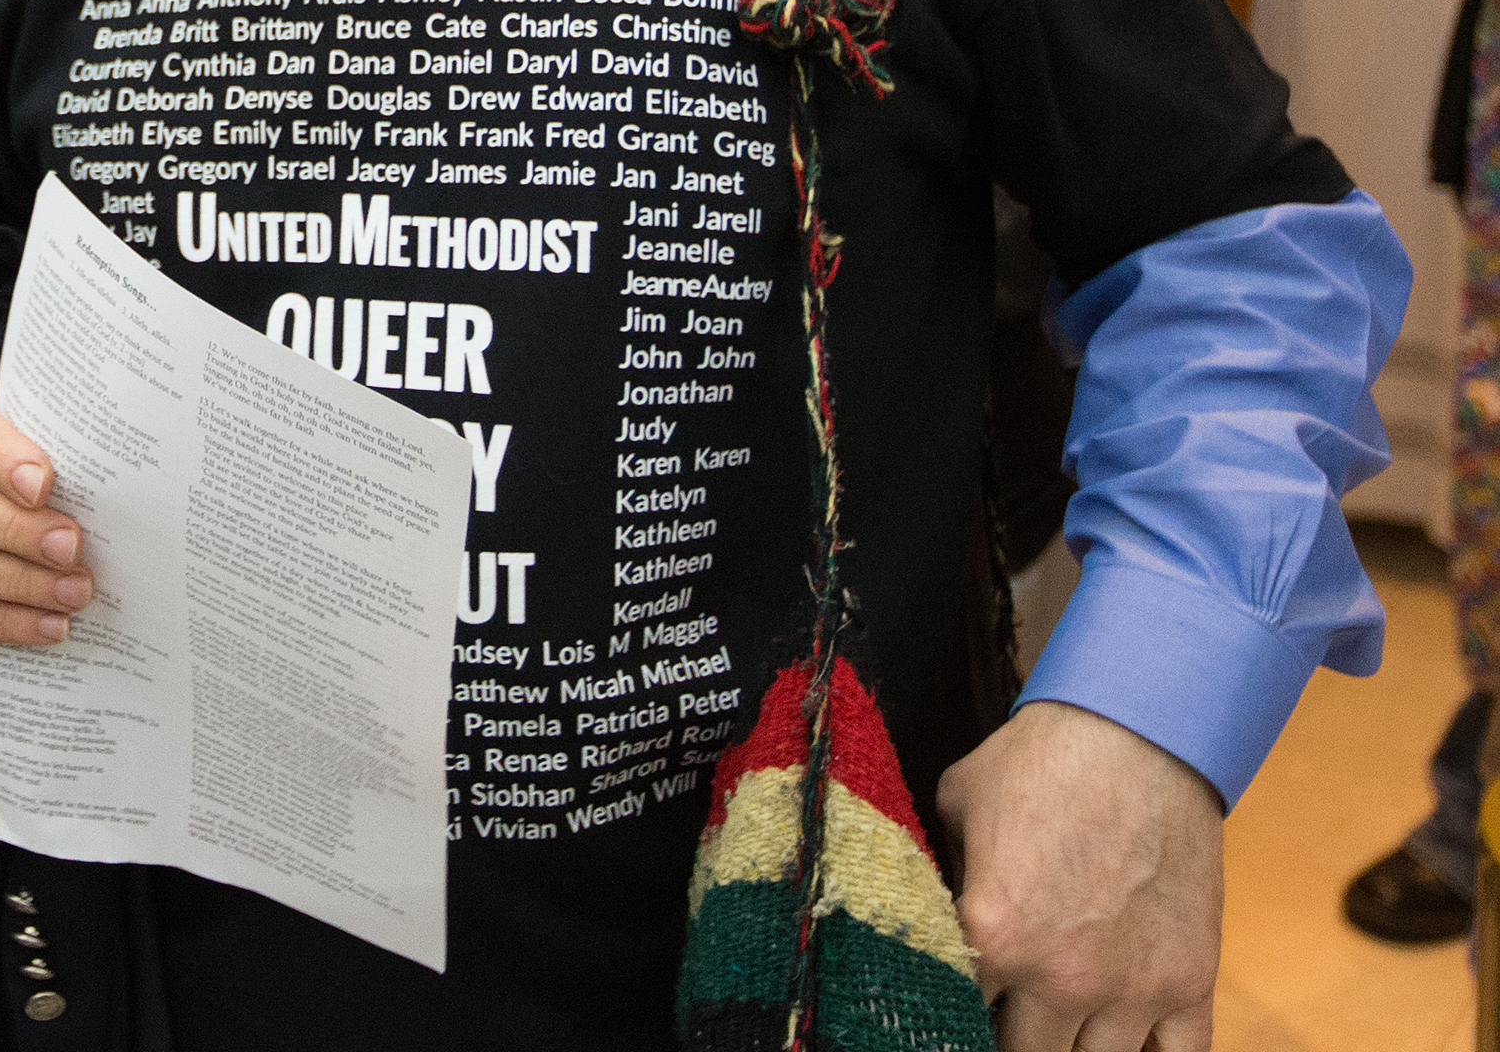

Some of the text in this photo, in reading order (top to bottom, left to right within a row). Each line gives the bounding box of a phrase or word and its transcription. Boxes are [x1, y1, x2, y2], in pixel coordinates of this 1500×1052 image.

[94, 13, 730, 49] Brenda Britt Brittany Bruce Cate Charles Christine
[69, 49, 758, 87] Courtney Cynthia Dan Dana Daniel Daryl David David
[57, 85, 766, 123] David Deborah Denyse Douglas Drew Edward Elizabeth
[53, 119, 775, 167] Elizabeth Elyse Emily Emily Frank Frank Fred Grant Greg
[70, 155, 744, 195] Gregory Gregory Israel Jacey James Jamie Jan Janet
[101, 192, 155, 214] Janet
[623, 201, 761, 233] Jani Jarell
[124, 219, 158, 247] Jay
[622, 235, 734, 265] Jeanelle
[75, 234, 121, 283] Redemption
[620, 307, 742, 335] Jim Joan
[266, 293, 494, 395] QUEER
[618, 344, 755, 369] John John
[617, 380, 733, 405] Jonathan
[616, 416, 676, 444] Judy
[617, 447, 750, 477] Karen Karen
[616, 485, 706, 514] Katelyn
[615, 519, 716, 549] Kathleen
[457, 551, 536, 625] UT
[615, 553, 712, 586] Kathleen
[614, 587, 692, 626] Kendall
[543, 640, 595, 665] Lois
[609, 631, 630, 657] M
[645, 614, 717, 647] Maggie
[451, 646, 731, 704] atthew Micah Michael
[465, 688, 741, 737] Pamela Patricia Peter
[485, 749, 568, 772] Renae
[582, 731, 672, 768] Richard
[471, 783, 574, 807] Siobhan
[590, 756, 667, 792] Sharon
[473, 816, 556, 839] Vivian
[567, 792, 645, 833] Wendy
[653, 771, 696, 800] Will
